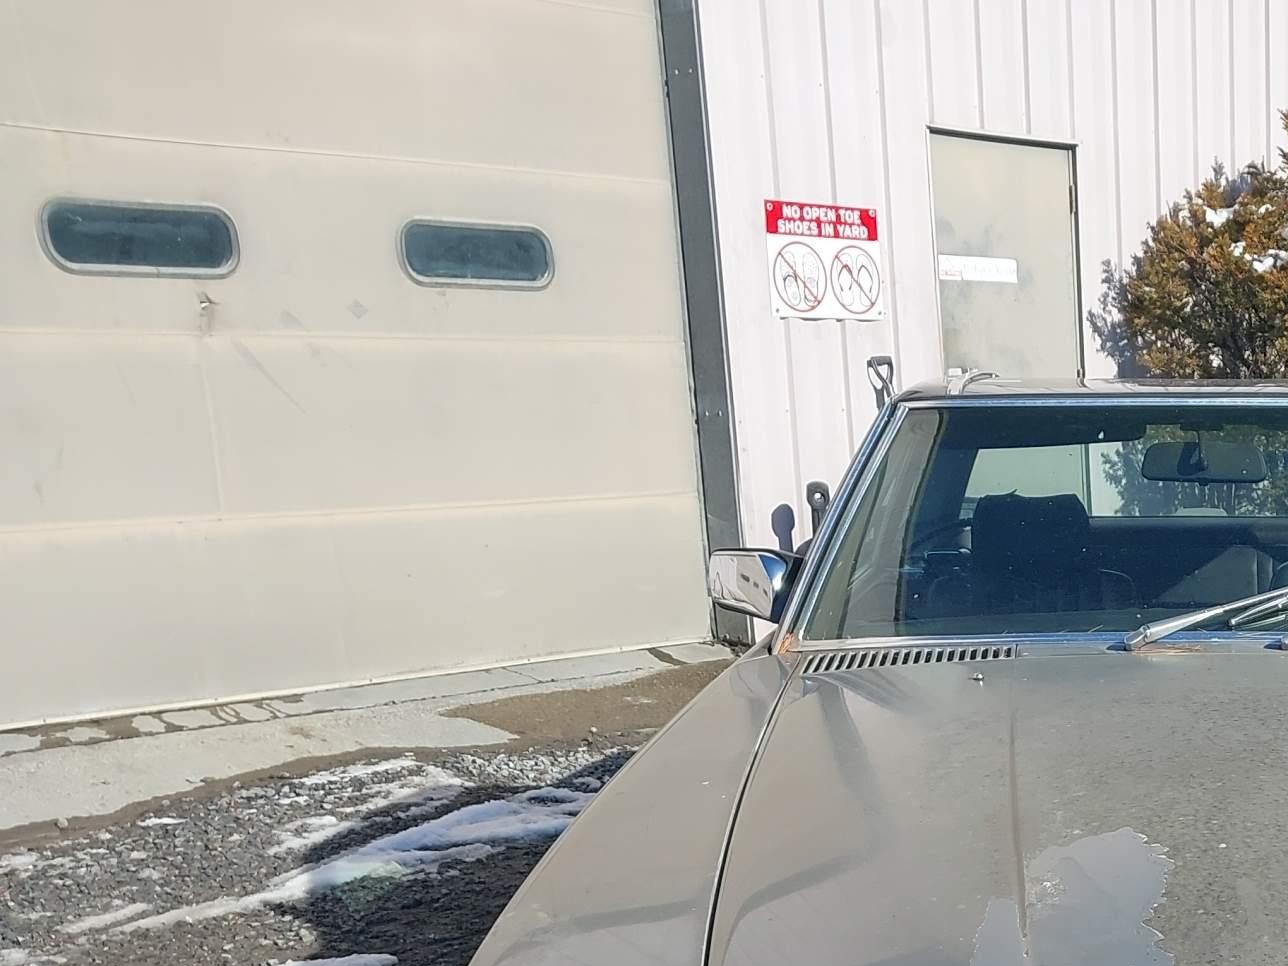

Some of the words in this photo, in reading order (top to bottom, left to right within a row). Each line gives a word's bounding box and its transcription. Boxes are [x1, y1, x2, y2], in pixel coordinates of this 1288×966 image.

[782, 205, 800, 219] NO
[803, 207, 836, 222] OPEN
[838, 210, 861, 223] TOE
[777, 219, 818, 234] SHOES
[821, 223, 834, 236] IN
[838, 225, 868, 239] YARD
